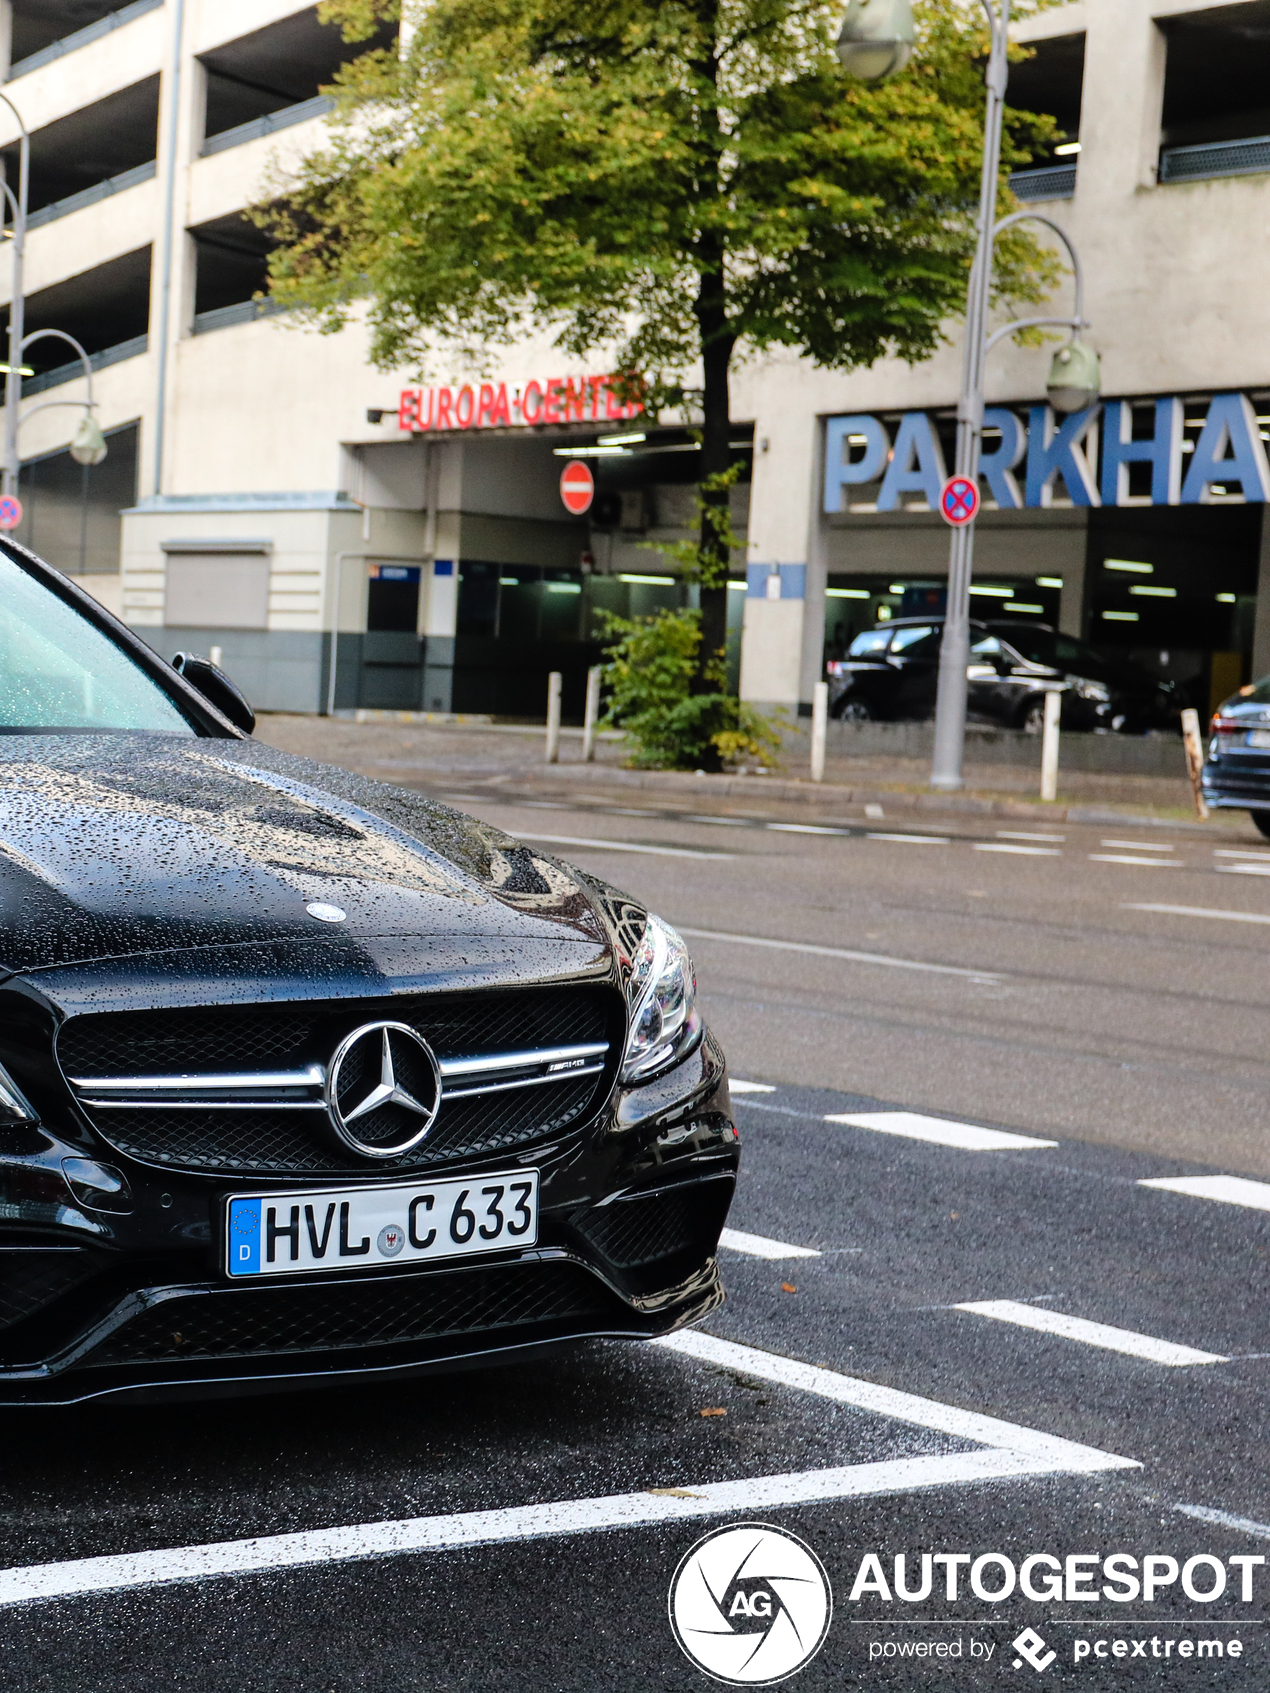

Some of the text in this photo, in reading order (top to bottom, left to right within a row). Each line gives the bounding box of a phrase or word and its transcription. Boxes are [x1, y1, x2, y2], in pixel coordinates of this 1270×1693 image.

[266, 1201, 371, 1262] HVL
[408, 1194, 437, 1249] C
[449, 1181, 533, 1244] 633
[239, 1244, 251, 1261] D
